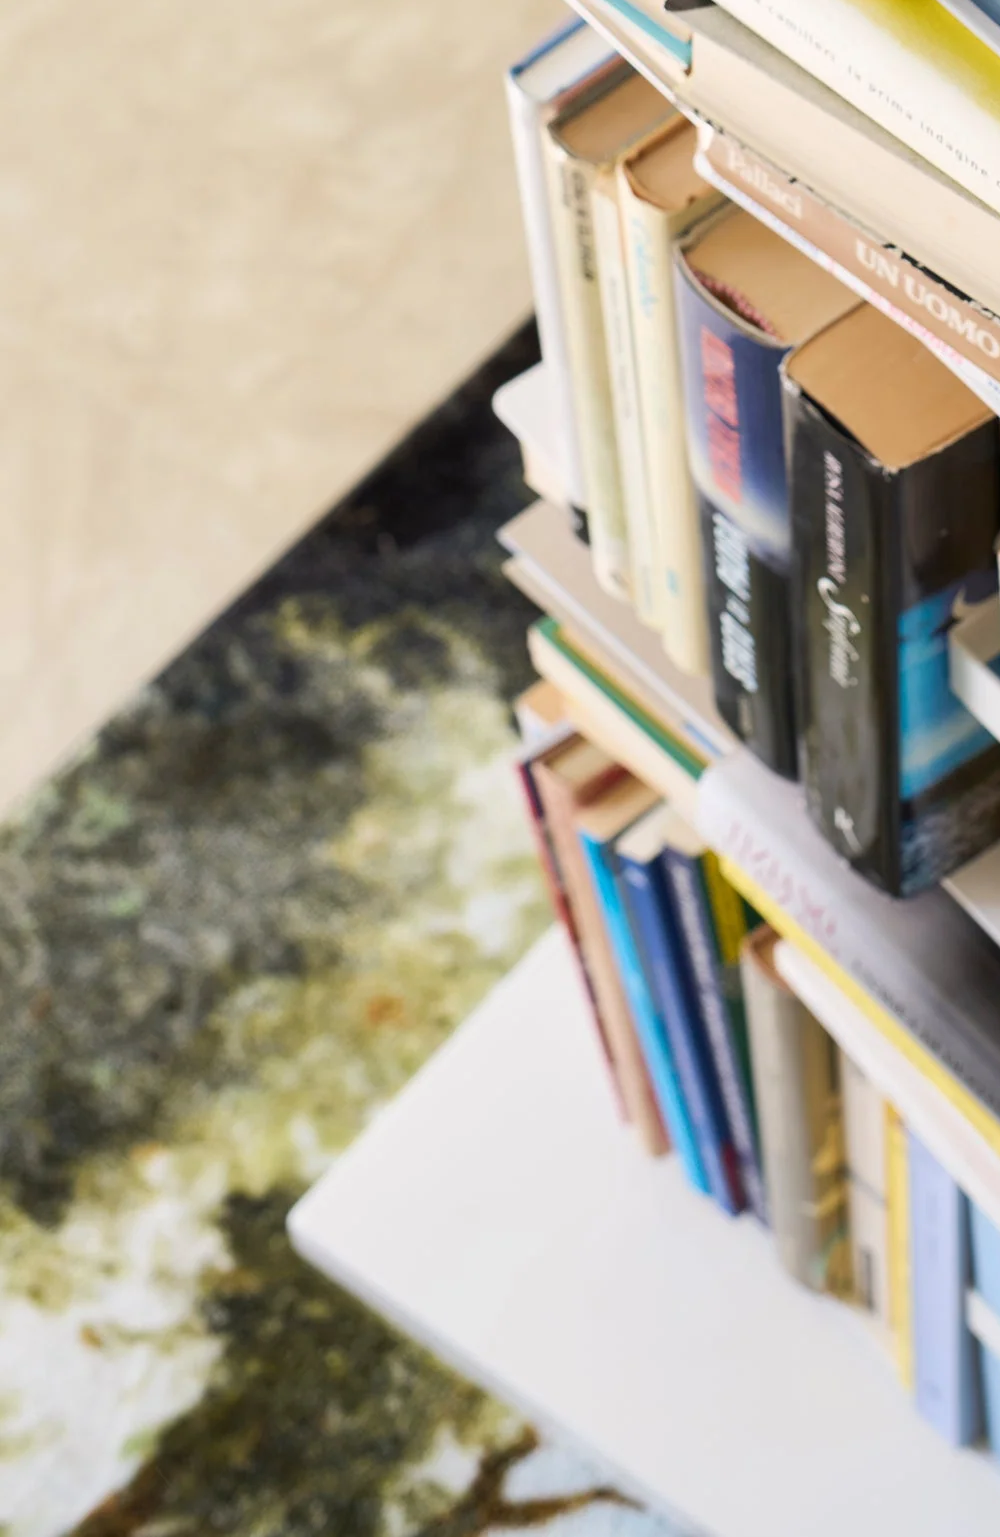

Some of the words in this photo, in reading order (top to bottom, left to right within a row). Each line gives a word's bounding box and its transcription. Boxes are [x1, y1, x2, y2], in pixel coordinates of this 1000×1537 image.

[847, 64, 862, 82] la
[868, 82, 913, 121] prima
[920, 122, 989, 177] indagine
[726, 146, 804, 220] Fallaci
[854, 238, 899, 289] UN
